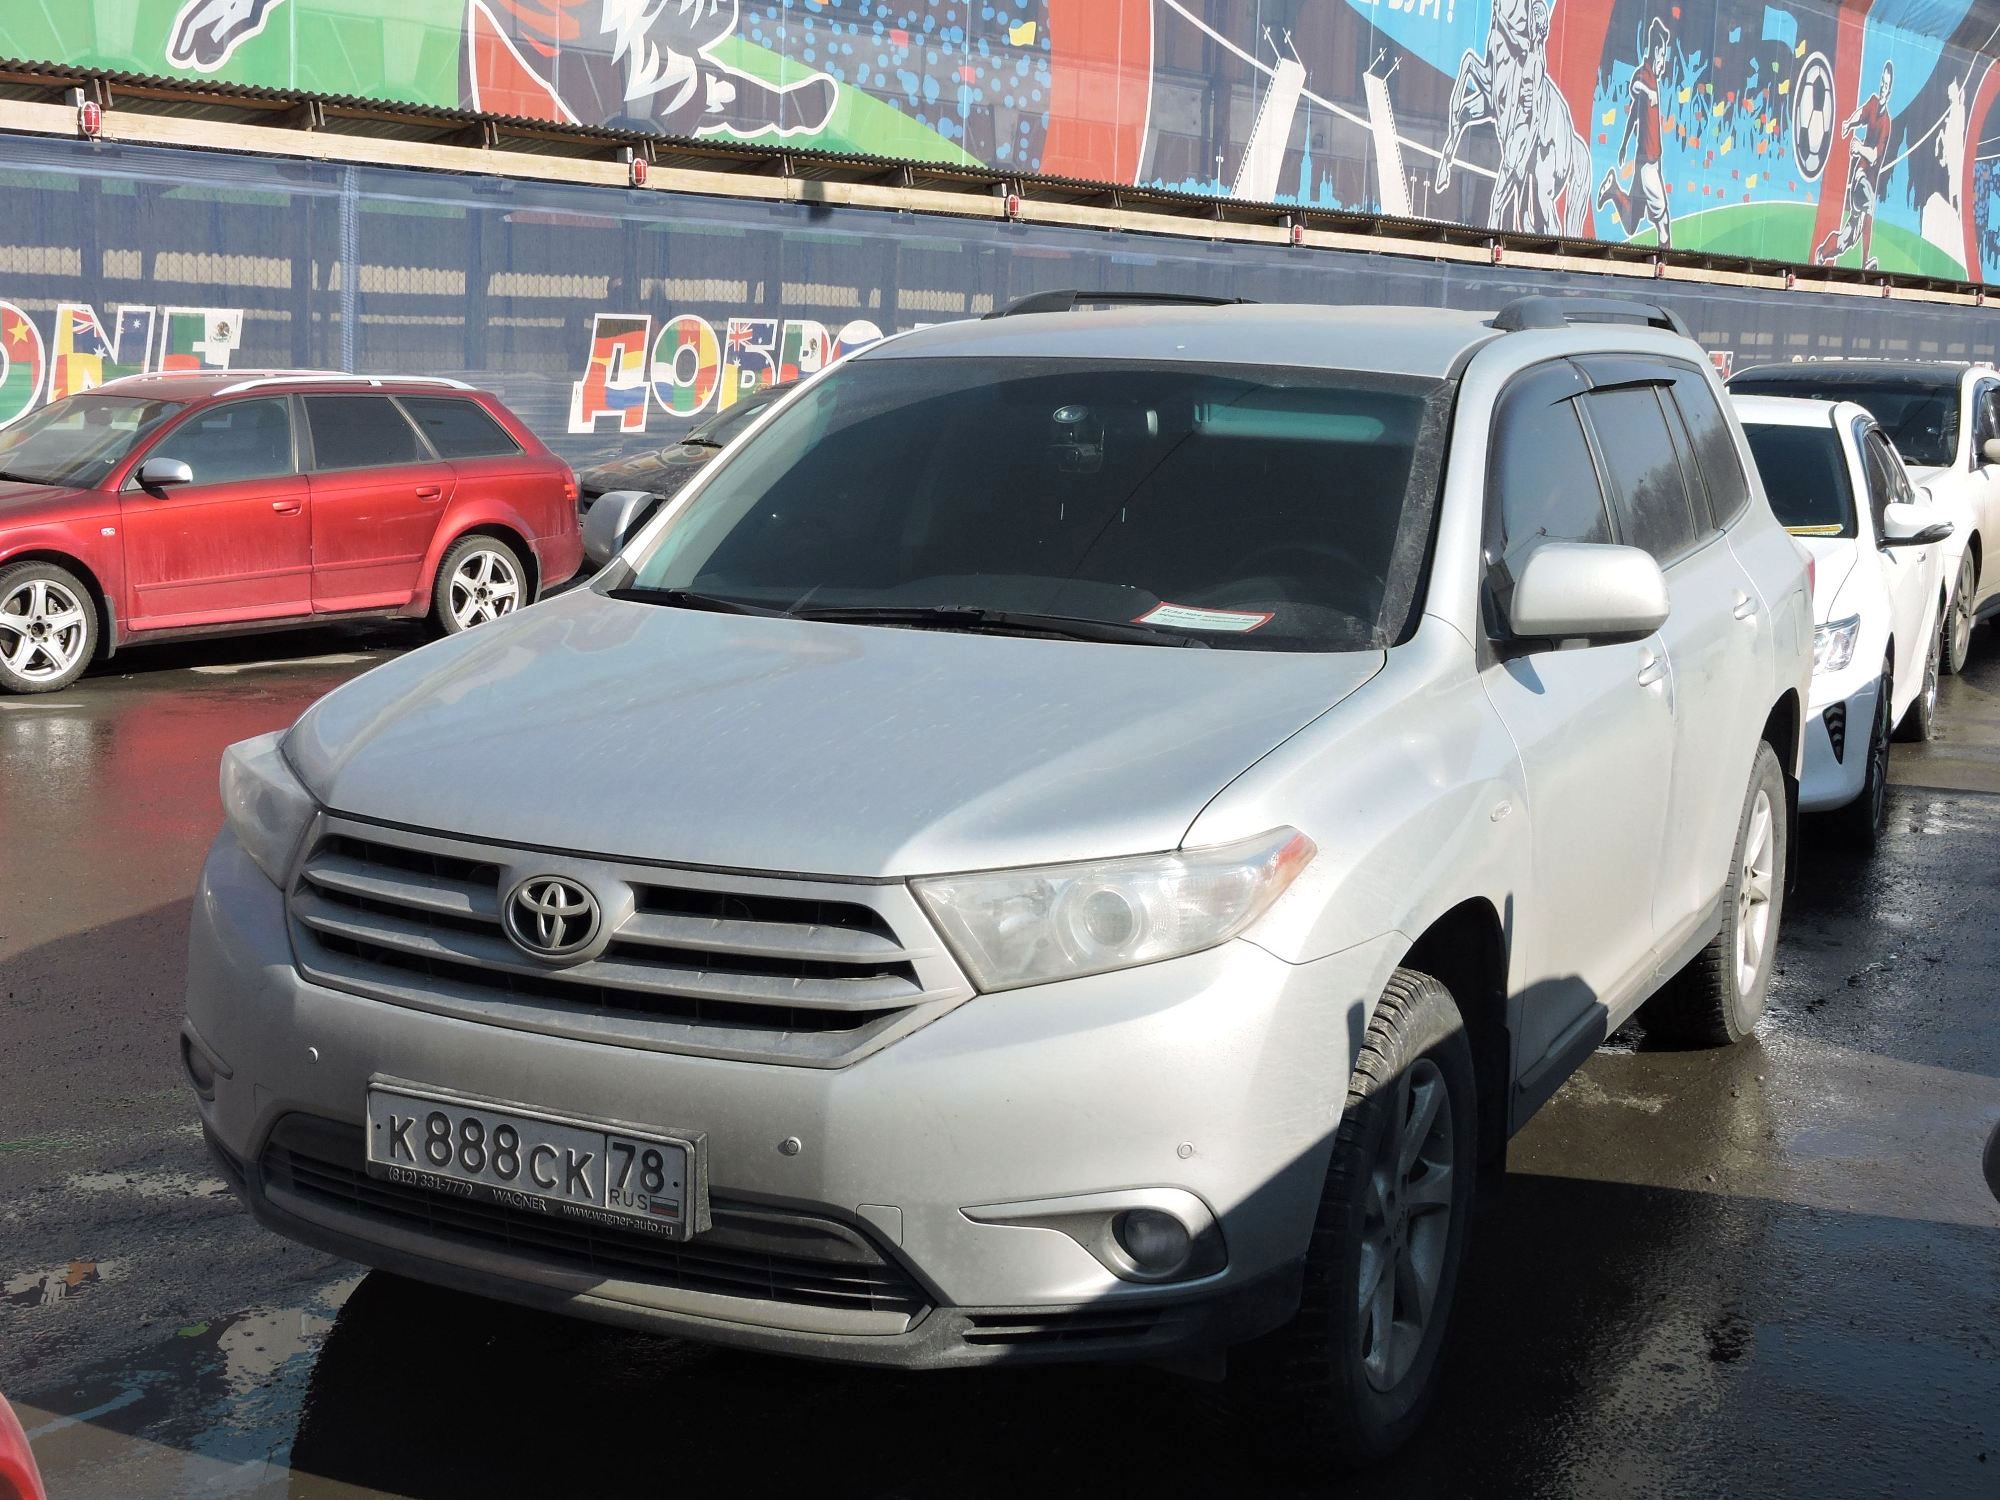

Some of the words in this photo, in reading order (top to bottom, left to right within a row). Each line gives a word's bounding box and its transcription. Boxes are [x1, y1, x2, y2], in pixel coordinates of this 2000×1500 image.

[612, 1142, 665, 1194] 78
[388, 1167, 417, 1184] (812)
[420, 1175, 473, 1196] 331-7779
[493, 1189, 547, 1212] WAGNER
[562, 1204, 673, 1236] www.wagner-auto.ru
[609, 1188, 648, 1211] RUS
